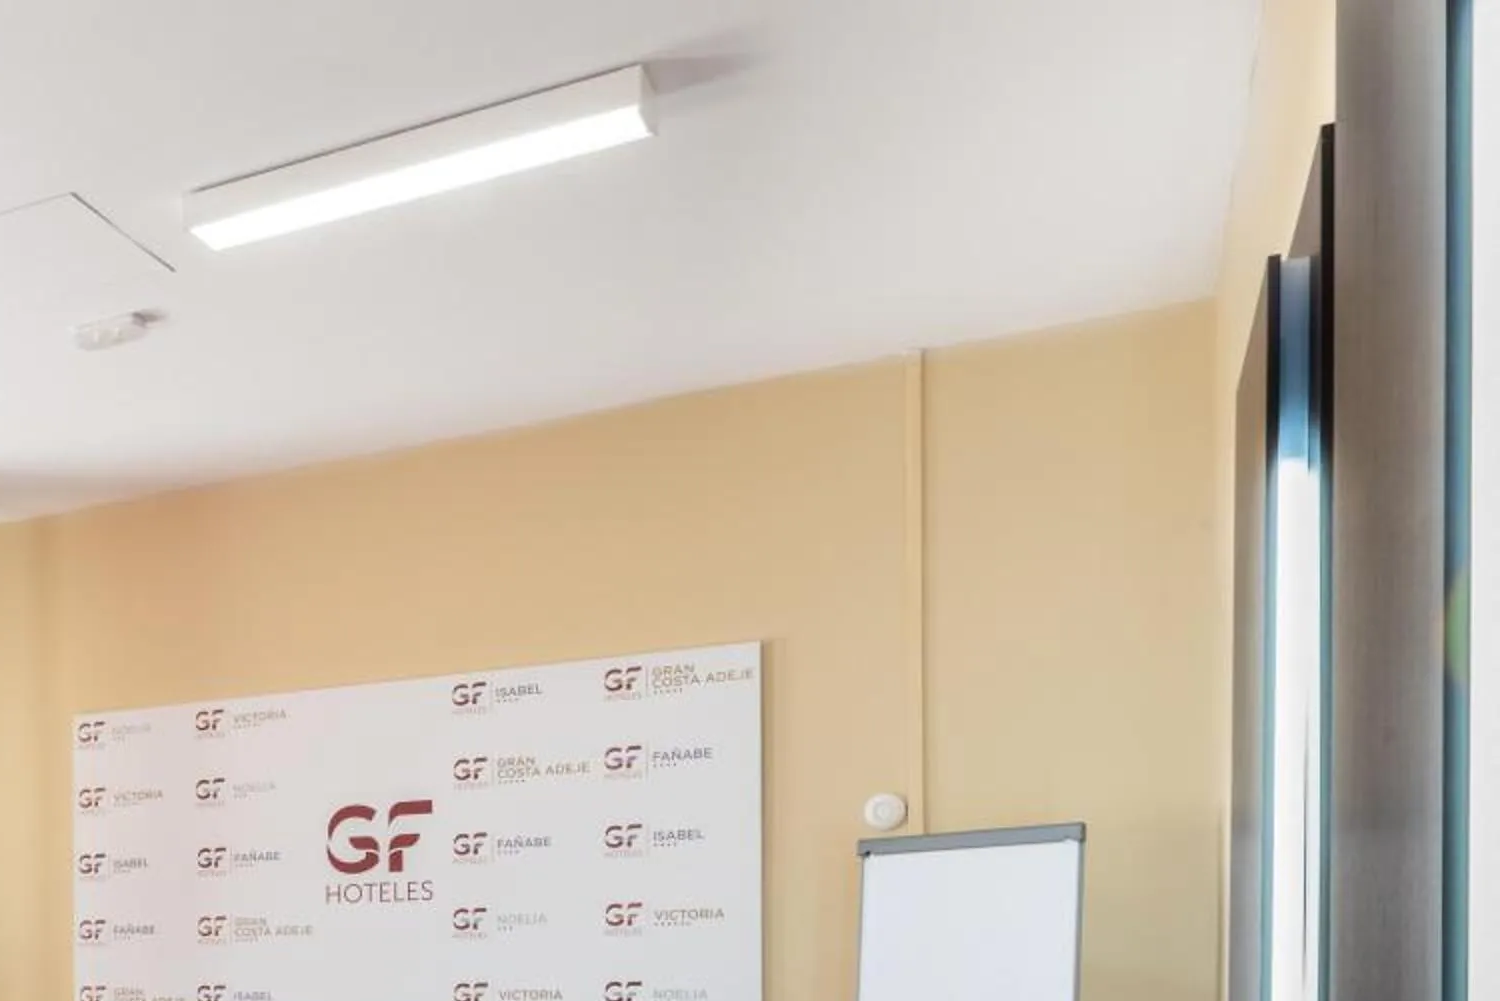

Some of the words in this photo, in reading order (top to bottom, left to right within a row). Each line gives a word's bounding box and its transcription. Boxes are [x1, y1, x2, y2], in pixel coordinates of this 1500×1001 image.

[652, 675, 701, 688] COSTA
[495, 683, 542, 697] ISABEL
[326, 799, 433, 874] GF
[653, 829, 705, 841] ISABEL
[325, 880, 434, 904] HOTELES
[653, 908, 725, 921] VICTORIA
[499, 989, 563, 1001] VICTORIA
